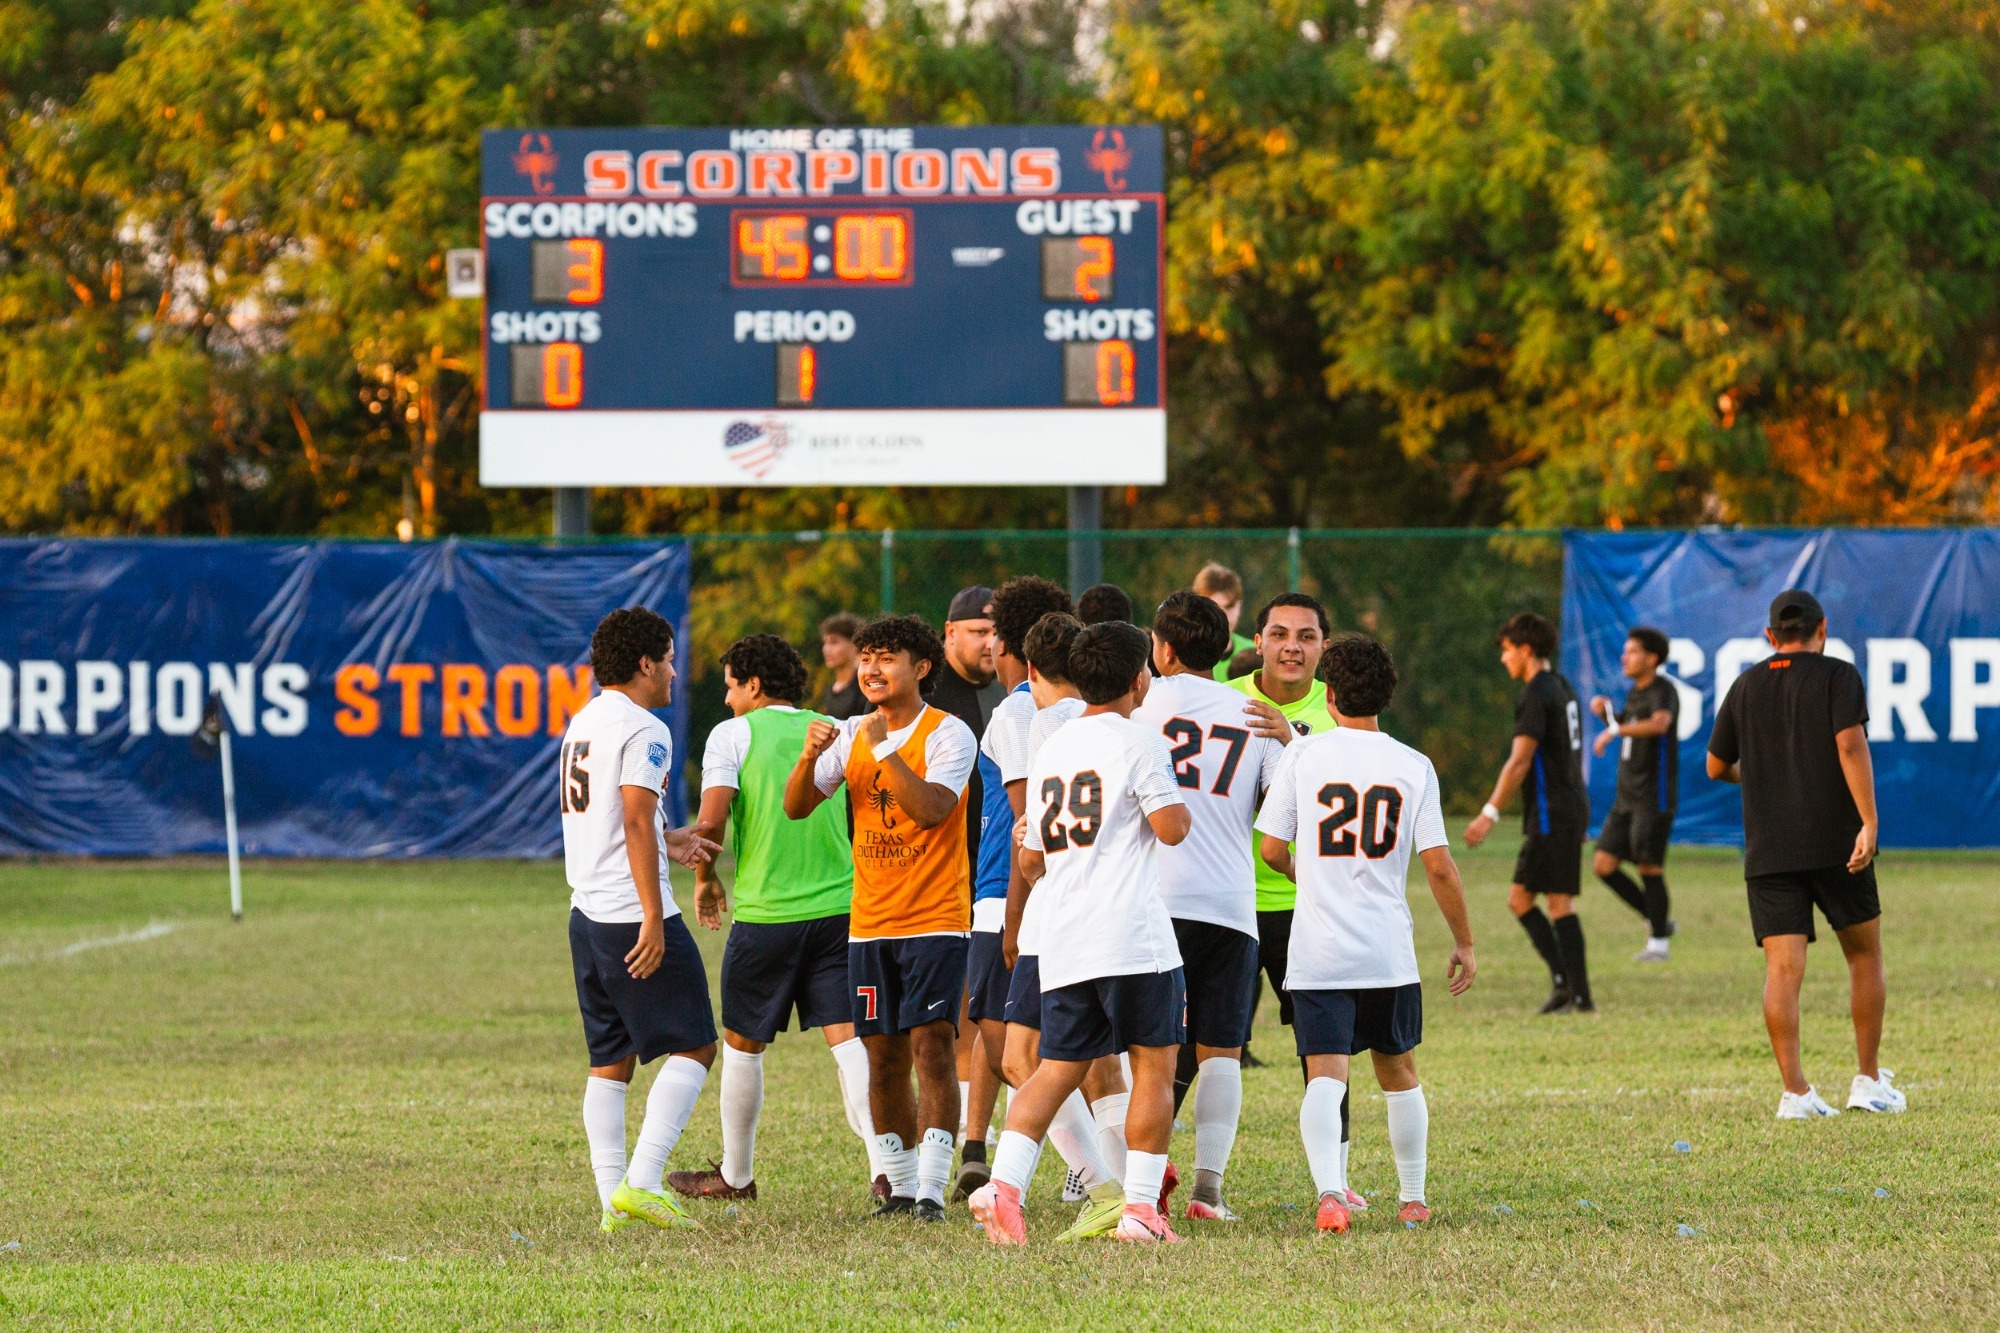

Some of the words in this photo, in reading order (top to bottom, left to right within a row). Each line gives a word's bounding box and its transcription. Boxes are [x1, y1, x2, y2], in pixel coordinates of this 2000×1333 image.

[730, 129, 812, 150] HOME
[815, 128, 855, 150] OF
[859, 128, 913, 149] THE
[584, 148, 1061, 197] SCORPIONS
[485, 202, 697, 237] SCORPIONS
[1016, 199, 1139, 234] GUEST
[567, 238, 604, 304] 3
[490, 311, 601, 343] SHOTS
[734, 310, 856, 343] PERIOD
[1043, 308, 1155, 341] SHOTS
[543, 342, 583, 408] 0
[799, 346, 815, 402] 1
[1096, 339, 1135, 406] 0
[0, 660, 310, 736] RPIONS
[561, 741, 591, 814] 15
[1163, 717, 1251, 798] 27
[1040, 769, 1103, 855] 29
[1317, 782, 1404, 860] 20
[857, 844, 929, 859] OUTHMOST
[865, 830, 904, 845] TEXAS
[857, 986, 878, 1020] 7
